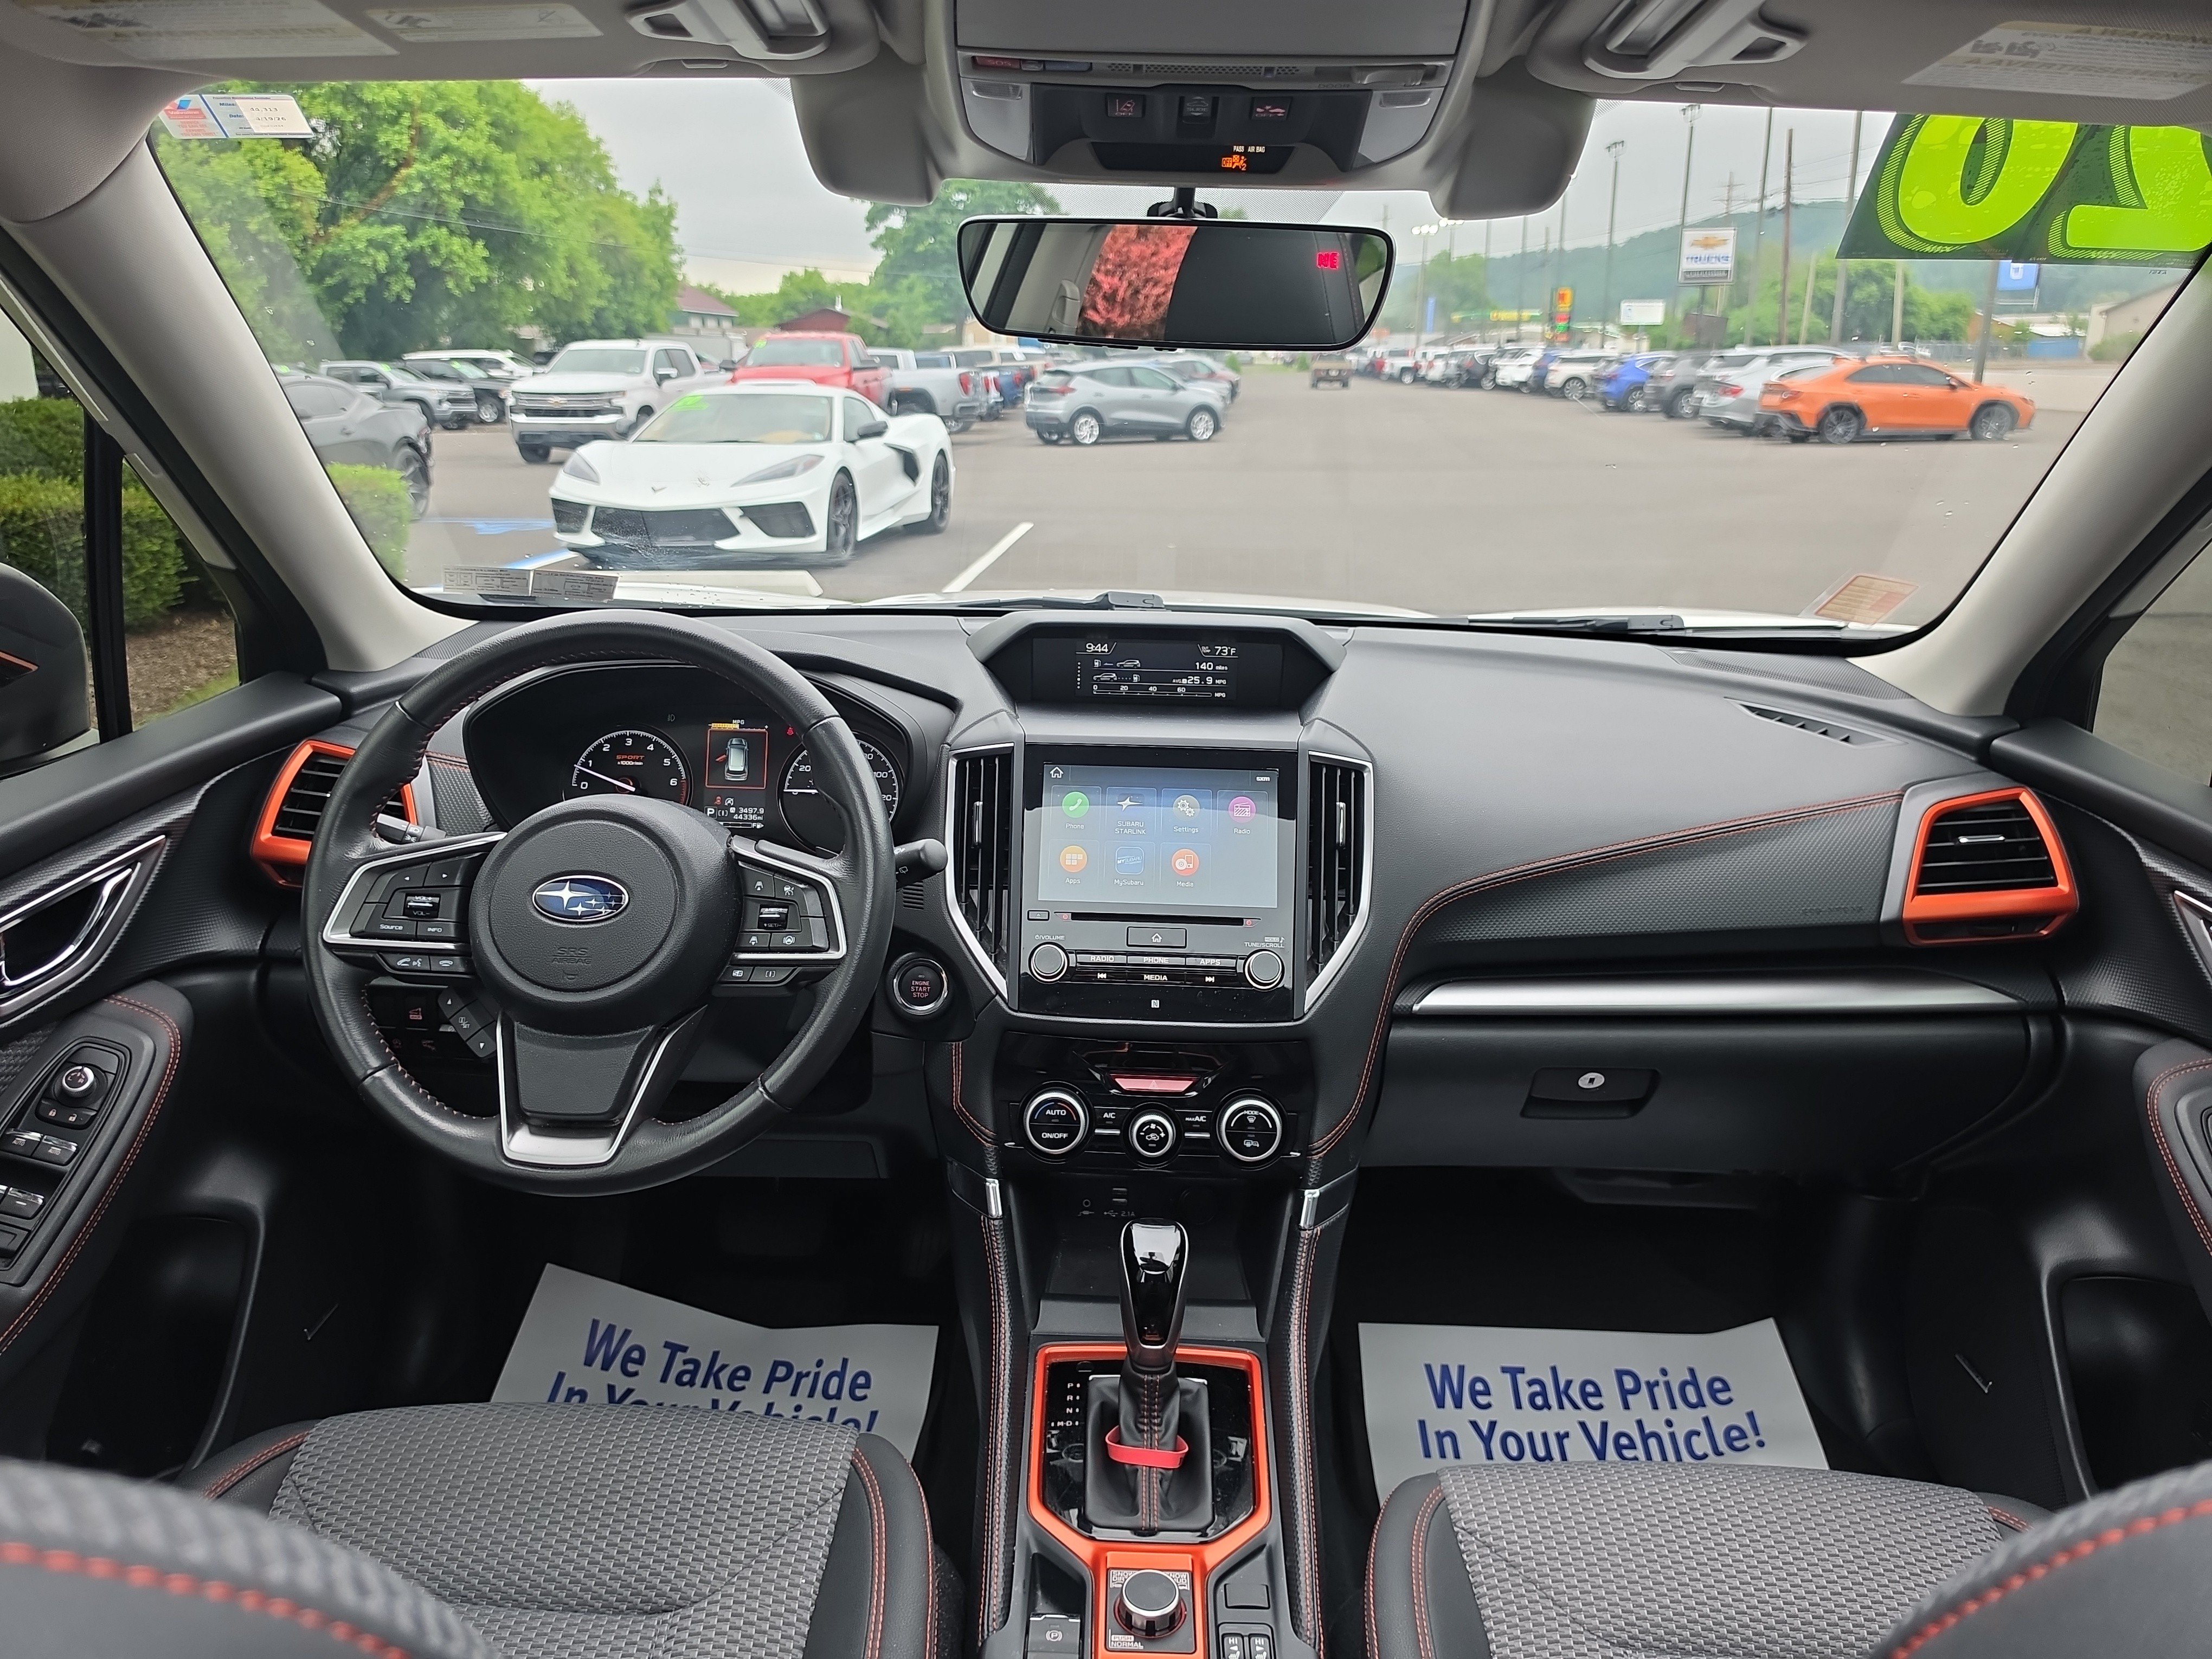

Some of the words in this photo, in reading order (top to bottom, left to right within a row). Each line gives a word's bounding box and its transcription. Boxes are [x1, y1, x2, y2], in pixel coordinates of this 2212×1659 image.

[1222, 158, 1232, 167] OFF
[1317, 253, 1339, 269] NE
[1085, 643, 1108, 653] 9:44
[1195, 662, 1213, 670] 140
[1187, 676, 1213, 684] 25.9
[625, 738, 632, 746] 3
[663, 758, 671, 766] 5
[580, 781, 588, 789] 0
[707, 807, 715, 816] P
[12, 1139, 26, 1147] AUTO
[582, 1318, 647, 1378] We
[659, 1340, 752, 1393] Take
[762, 1357, 873, 1402] Pride
[1423, 1363, 1493, 1411] We
[1500, 1364, 1604, 1411] Take
[1613, 1366, 1734, 1412] Pride
[1417, 1418, 1461, 1460] In
[1468, 1418, 1572, 1462] Your
[1578, 1410, 1767, 1462] Vehicle!
